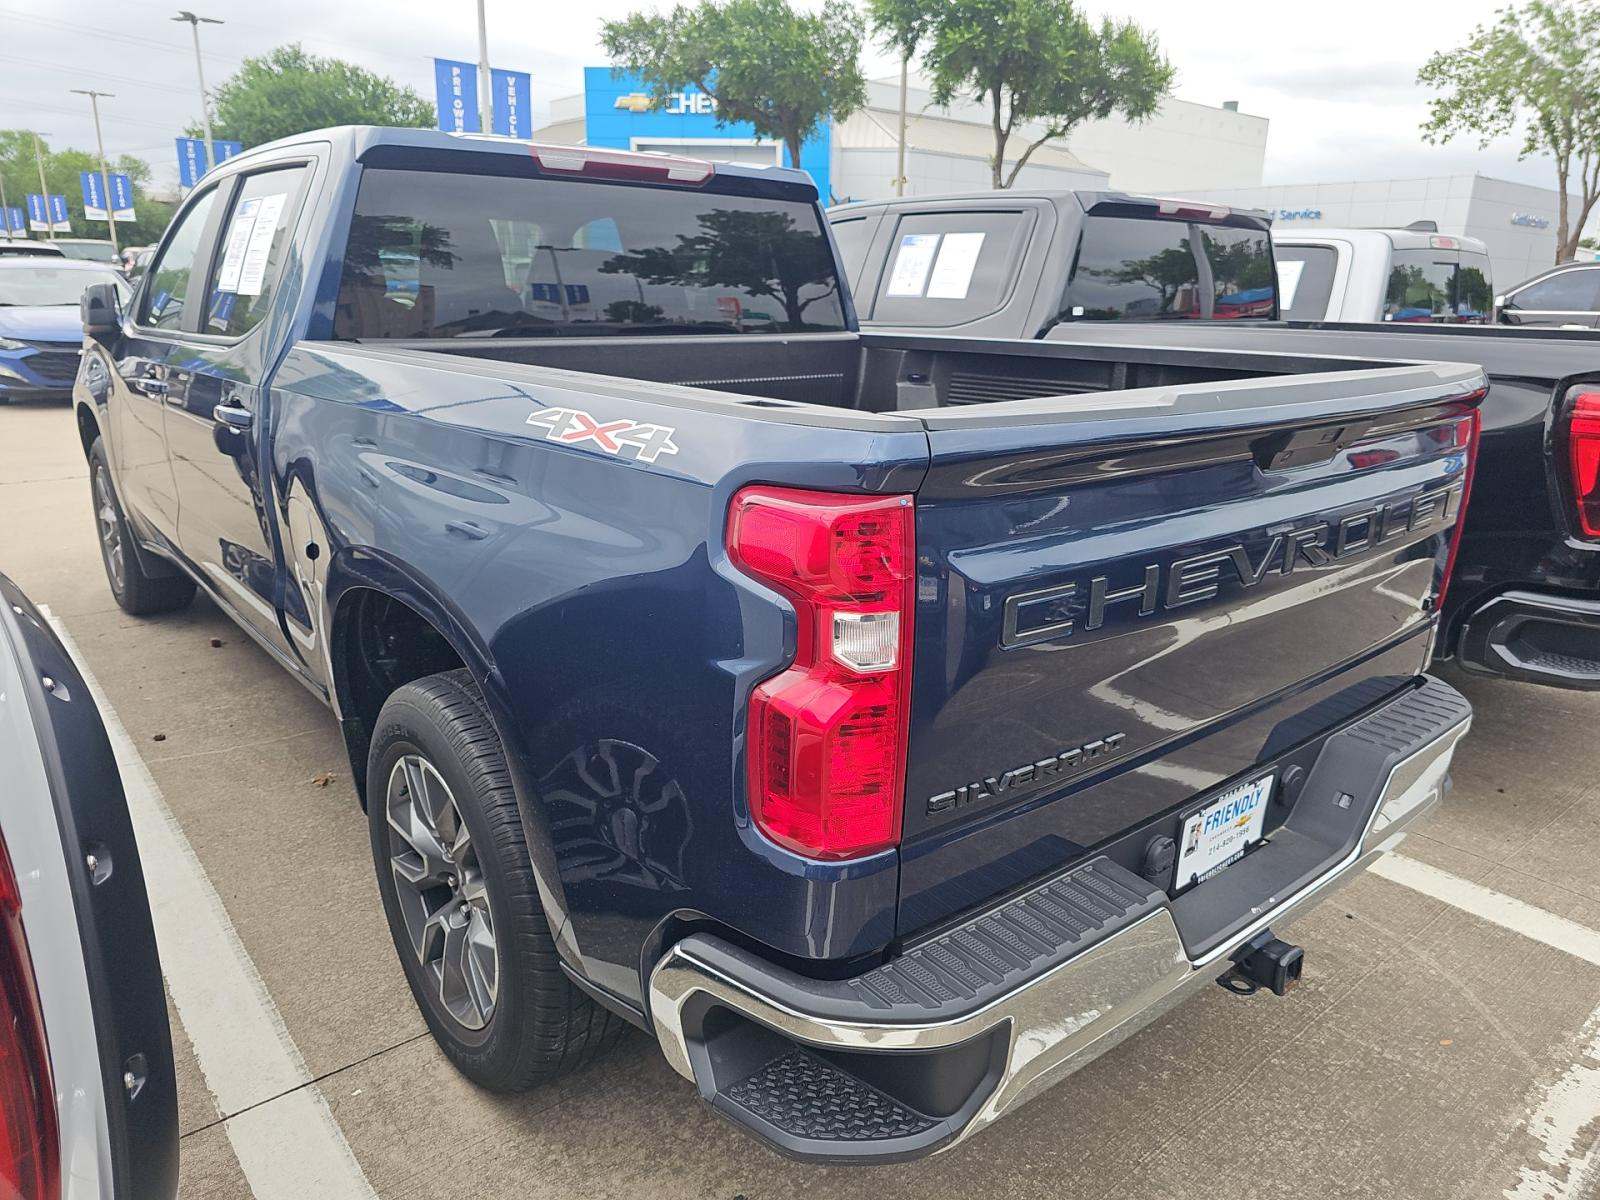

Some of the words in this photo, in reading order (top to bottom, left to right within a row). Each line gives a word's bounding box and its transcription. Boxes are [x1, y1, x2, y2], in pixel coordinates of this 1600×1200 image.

[452, 67, 462, 96] PRE
[1279, 207, 1321, 221] Service
[999, 486, 1458, 650] CHEVROLET
[926, 732, 1127, 816] SILVERADO
[1204, 787, 1263, 835] FRIENDLY
